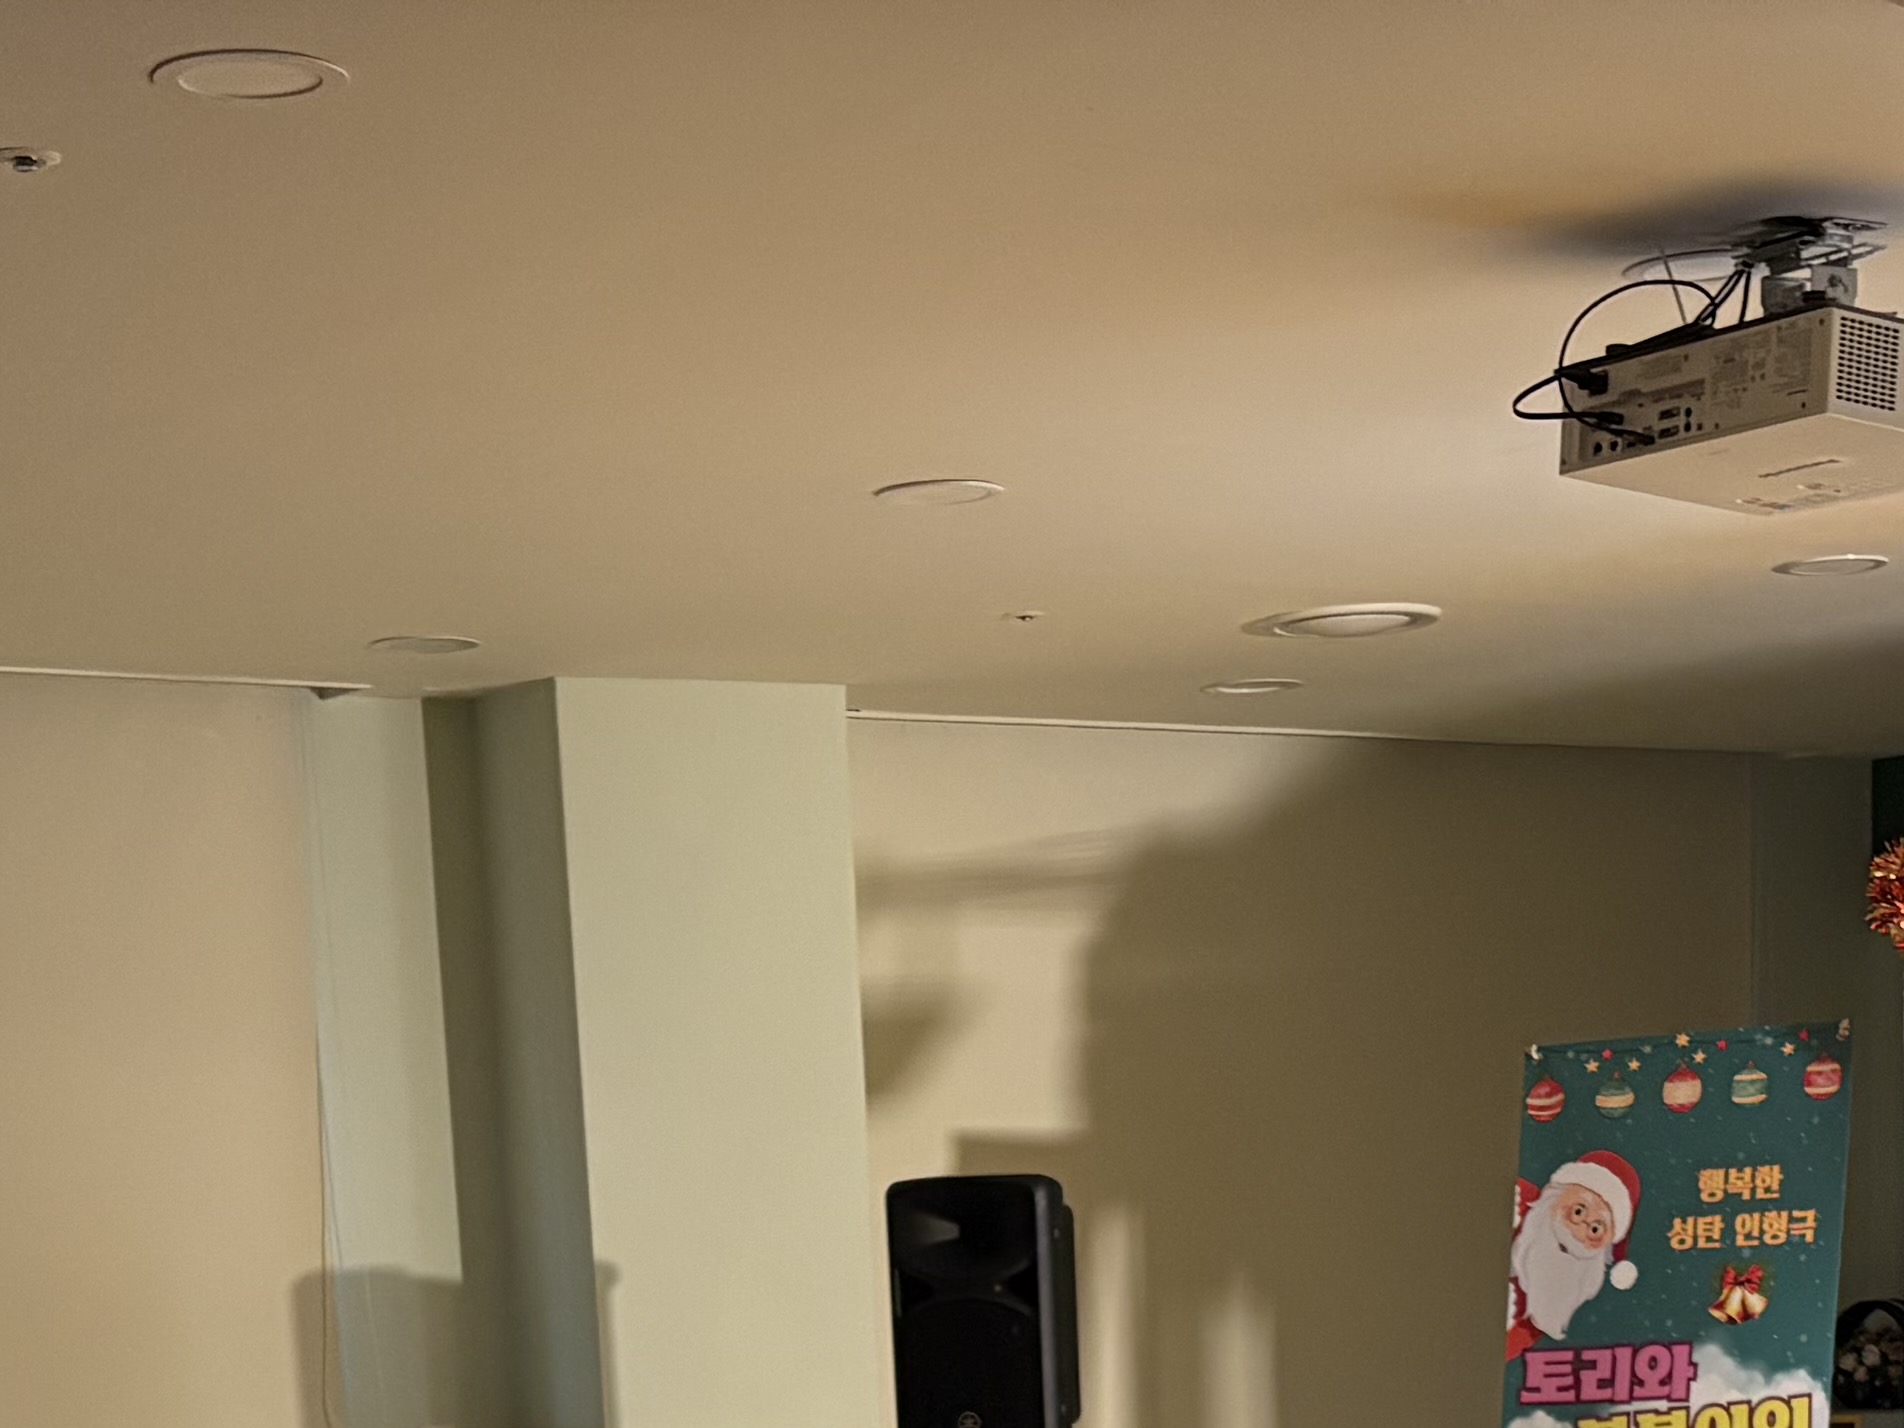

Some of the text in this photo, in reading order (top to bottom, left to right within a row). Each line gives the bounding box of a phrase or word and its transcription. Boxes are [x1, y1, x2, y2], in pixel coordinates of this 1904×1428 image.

[1698, 1164, 1783, 1203] 행복한
[1667, 1208, 1817, 1250] 성탄 인형극
[1519, 1341, 1697, 1405] 토리와
